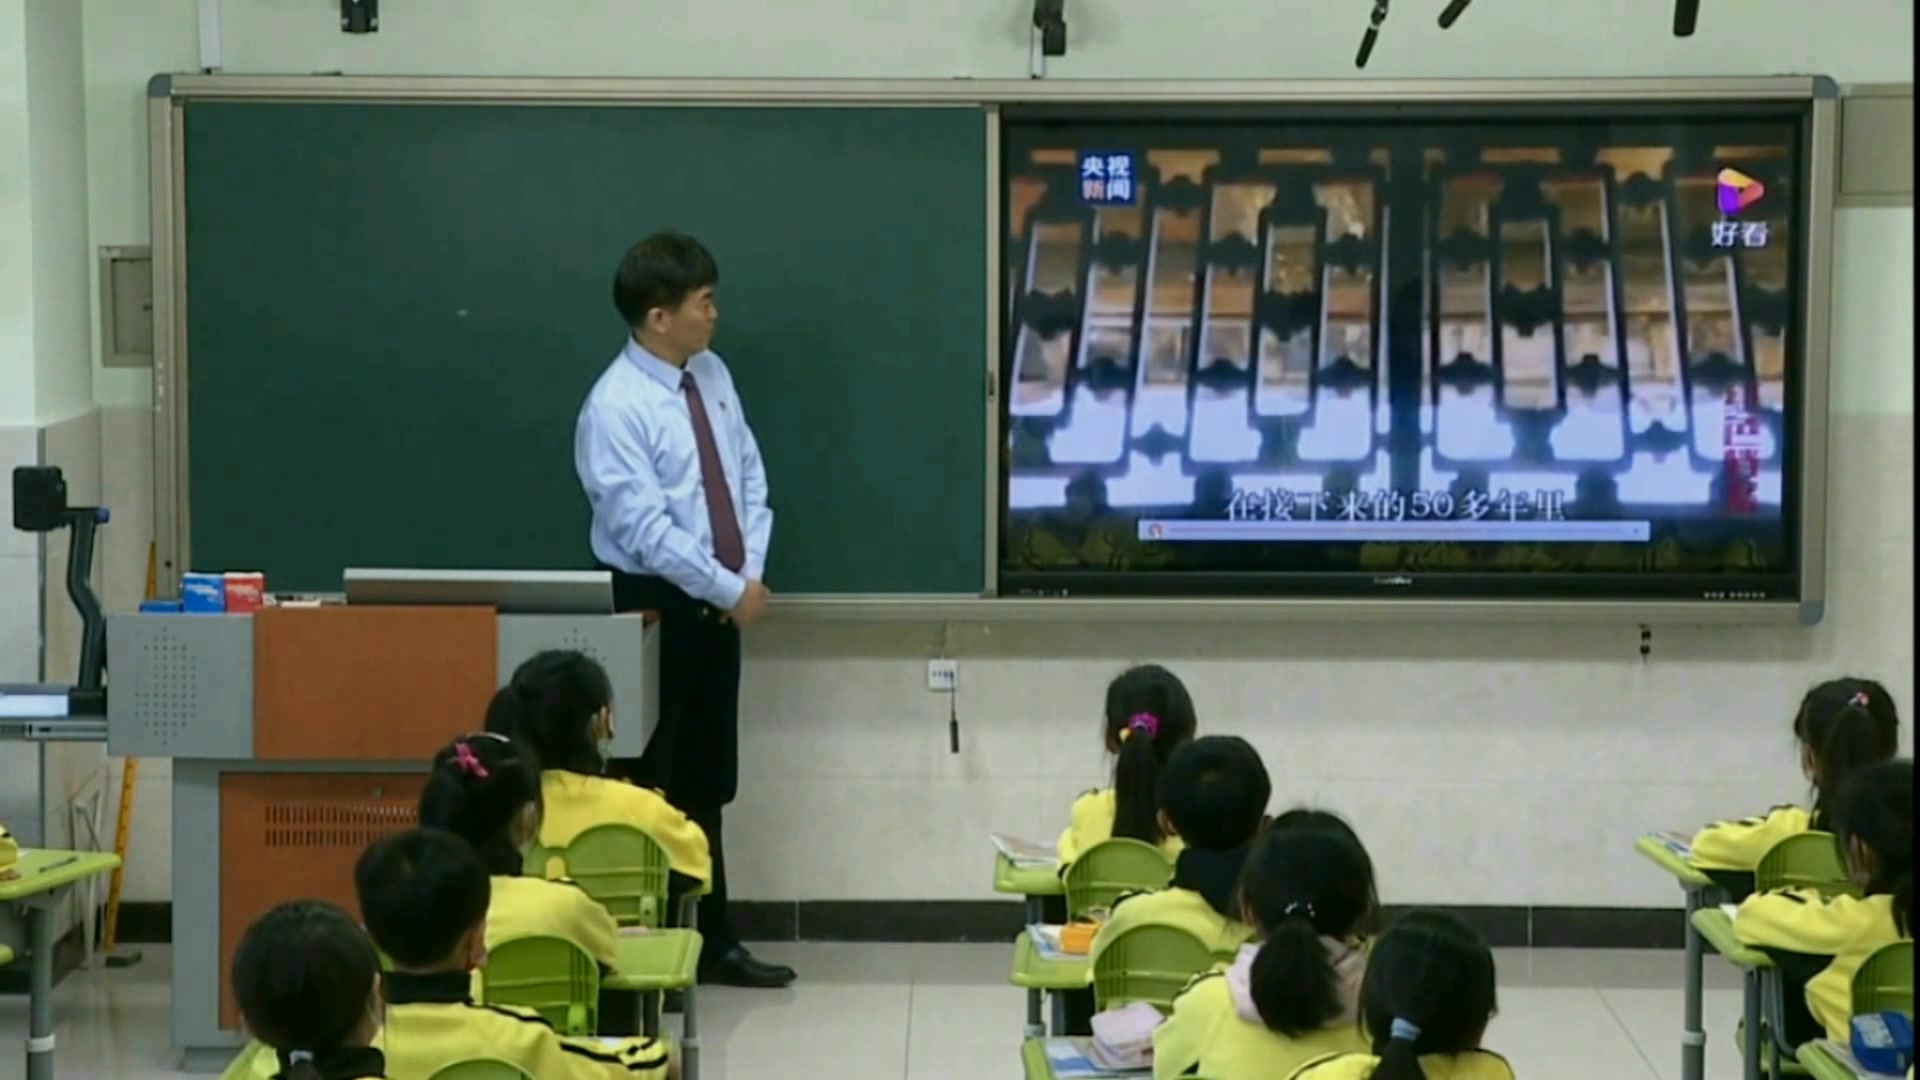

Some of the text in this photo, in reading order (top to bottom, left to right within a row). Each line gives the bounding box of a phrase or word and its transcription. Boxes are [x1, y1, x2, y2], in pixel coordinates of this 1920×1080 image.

[1082, 155, 1130, 176] 央视
[1082, 179, 1130, 200] 新闻
[1711, 221, 1769, 247] 好看
[1224, 489, 1566, 521] 在接下来的50多年里
